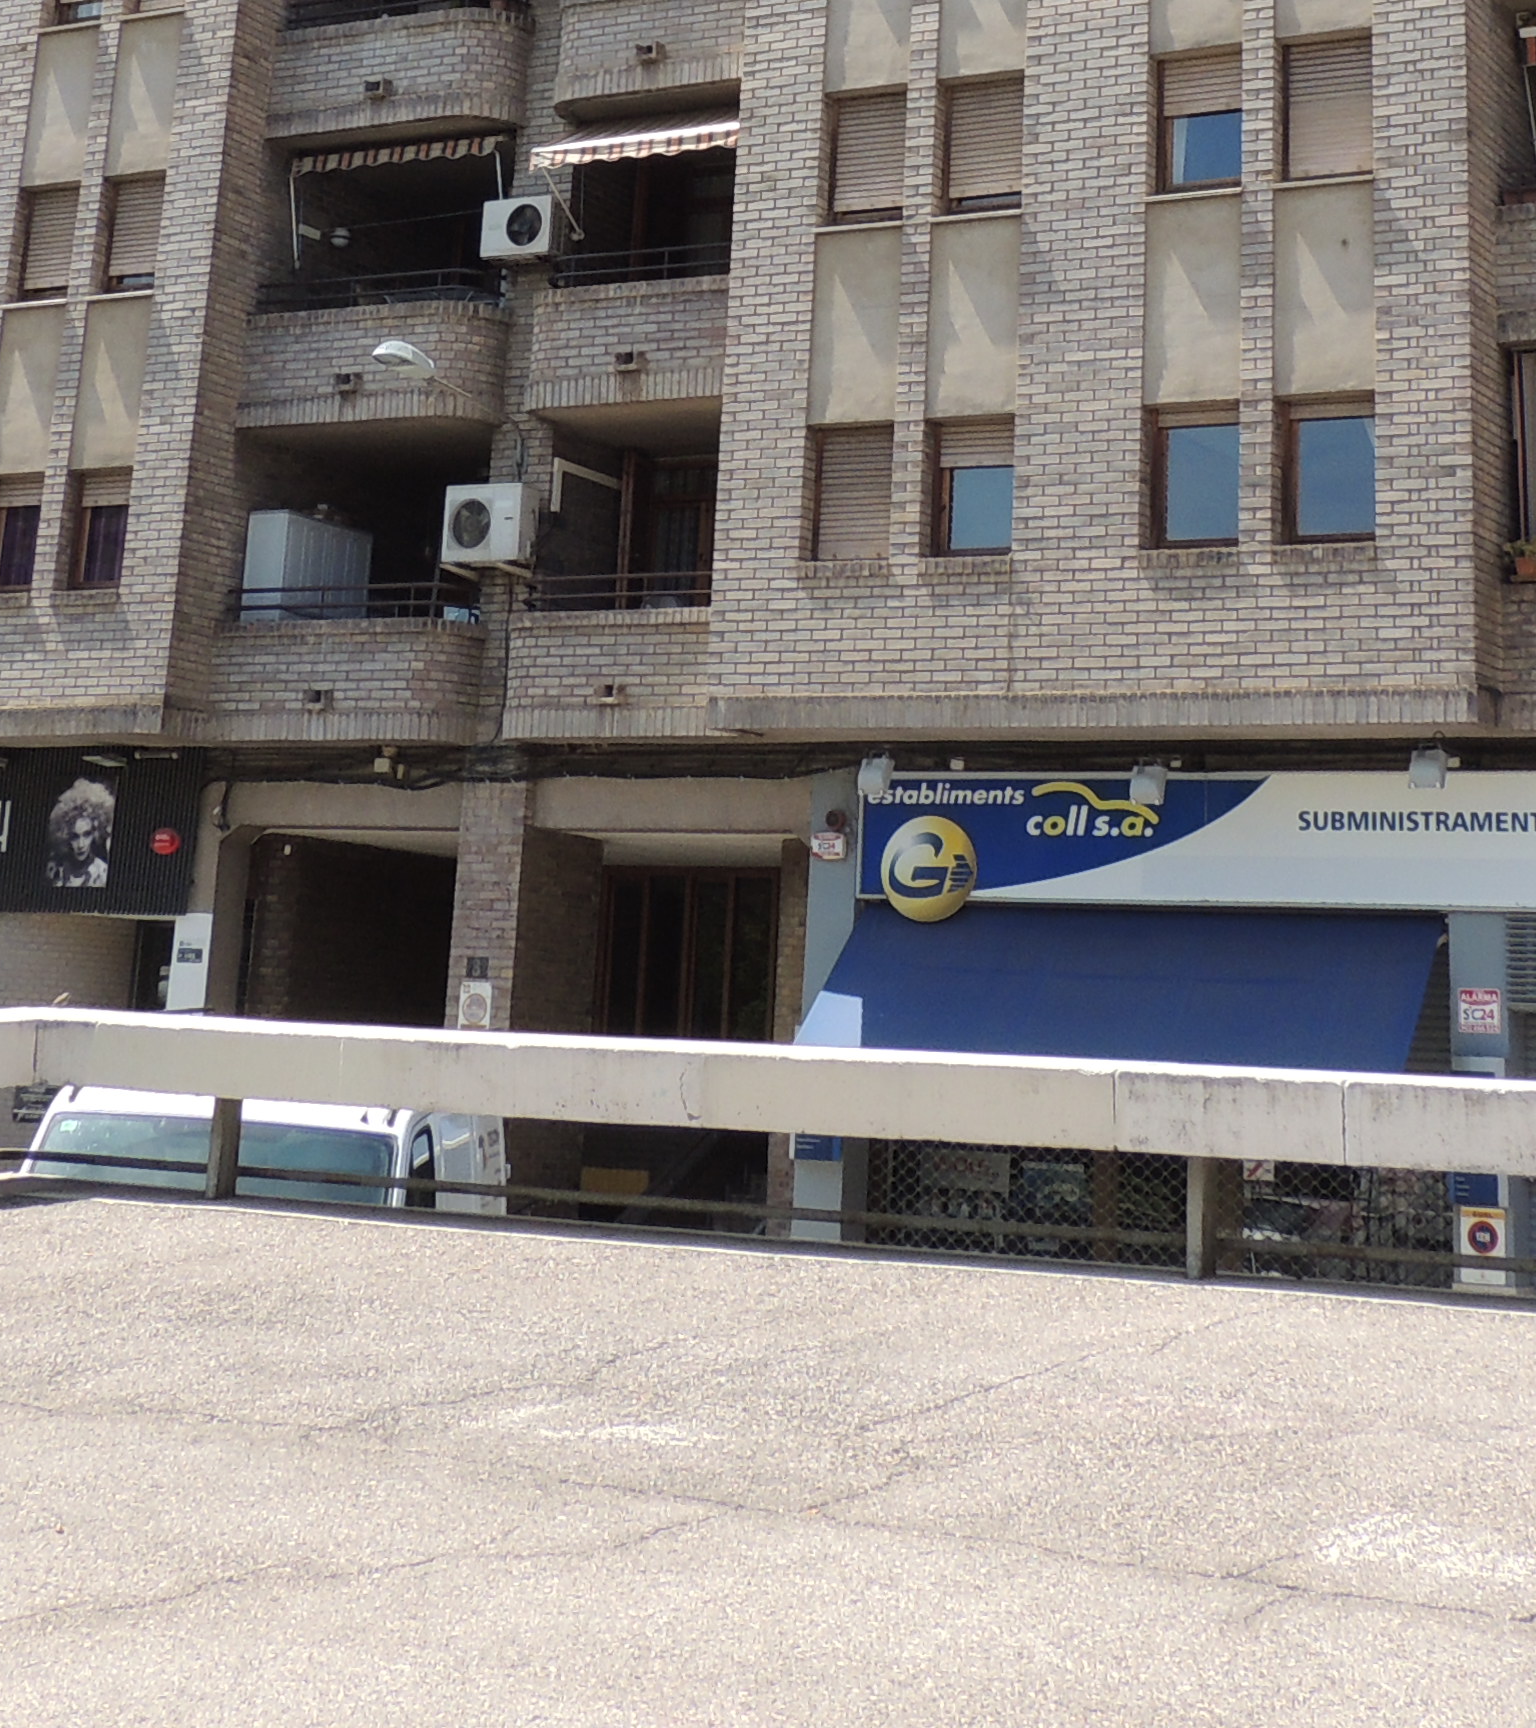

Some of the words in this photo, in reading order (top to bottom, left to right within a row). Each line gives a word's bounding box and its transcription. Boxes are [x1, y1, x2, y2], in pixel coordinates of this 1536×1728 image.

[867, 782, 1025, 805] establiments
[1026, 805, 1089, 836] coll
[1092, 814, 1154, 837] s.a.
